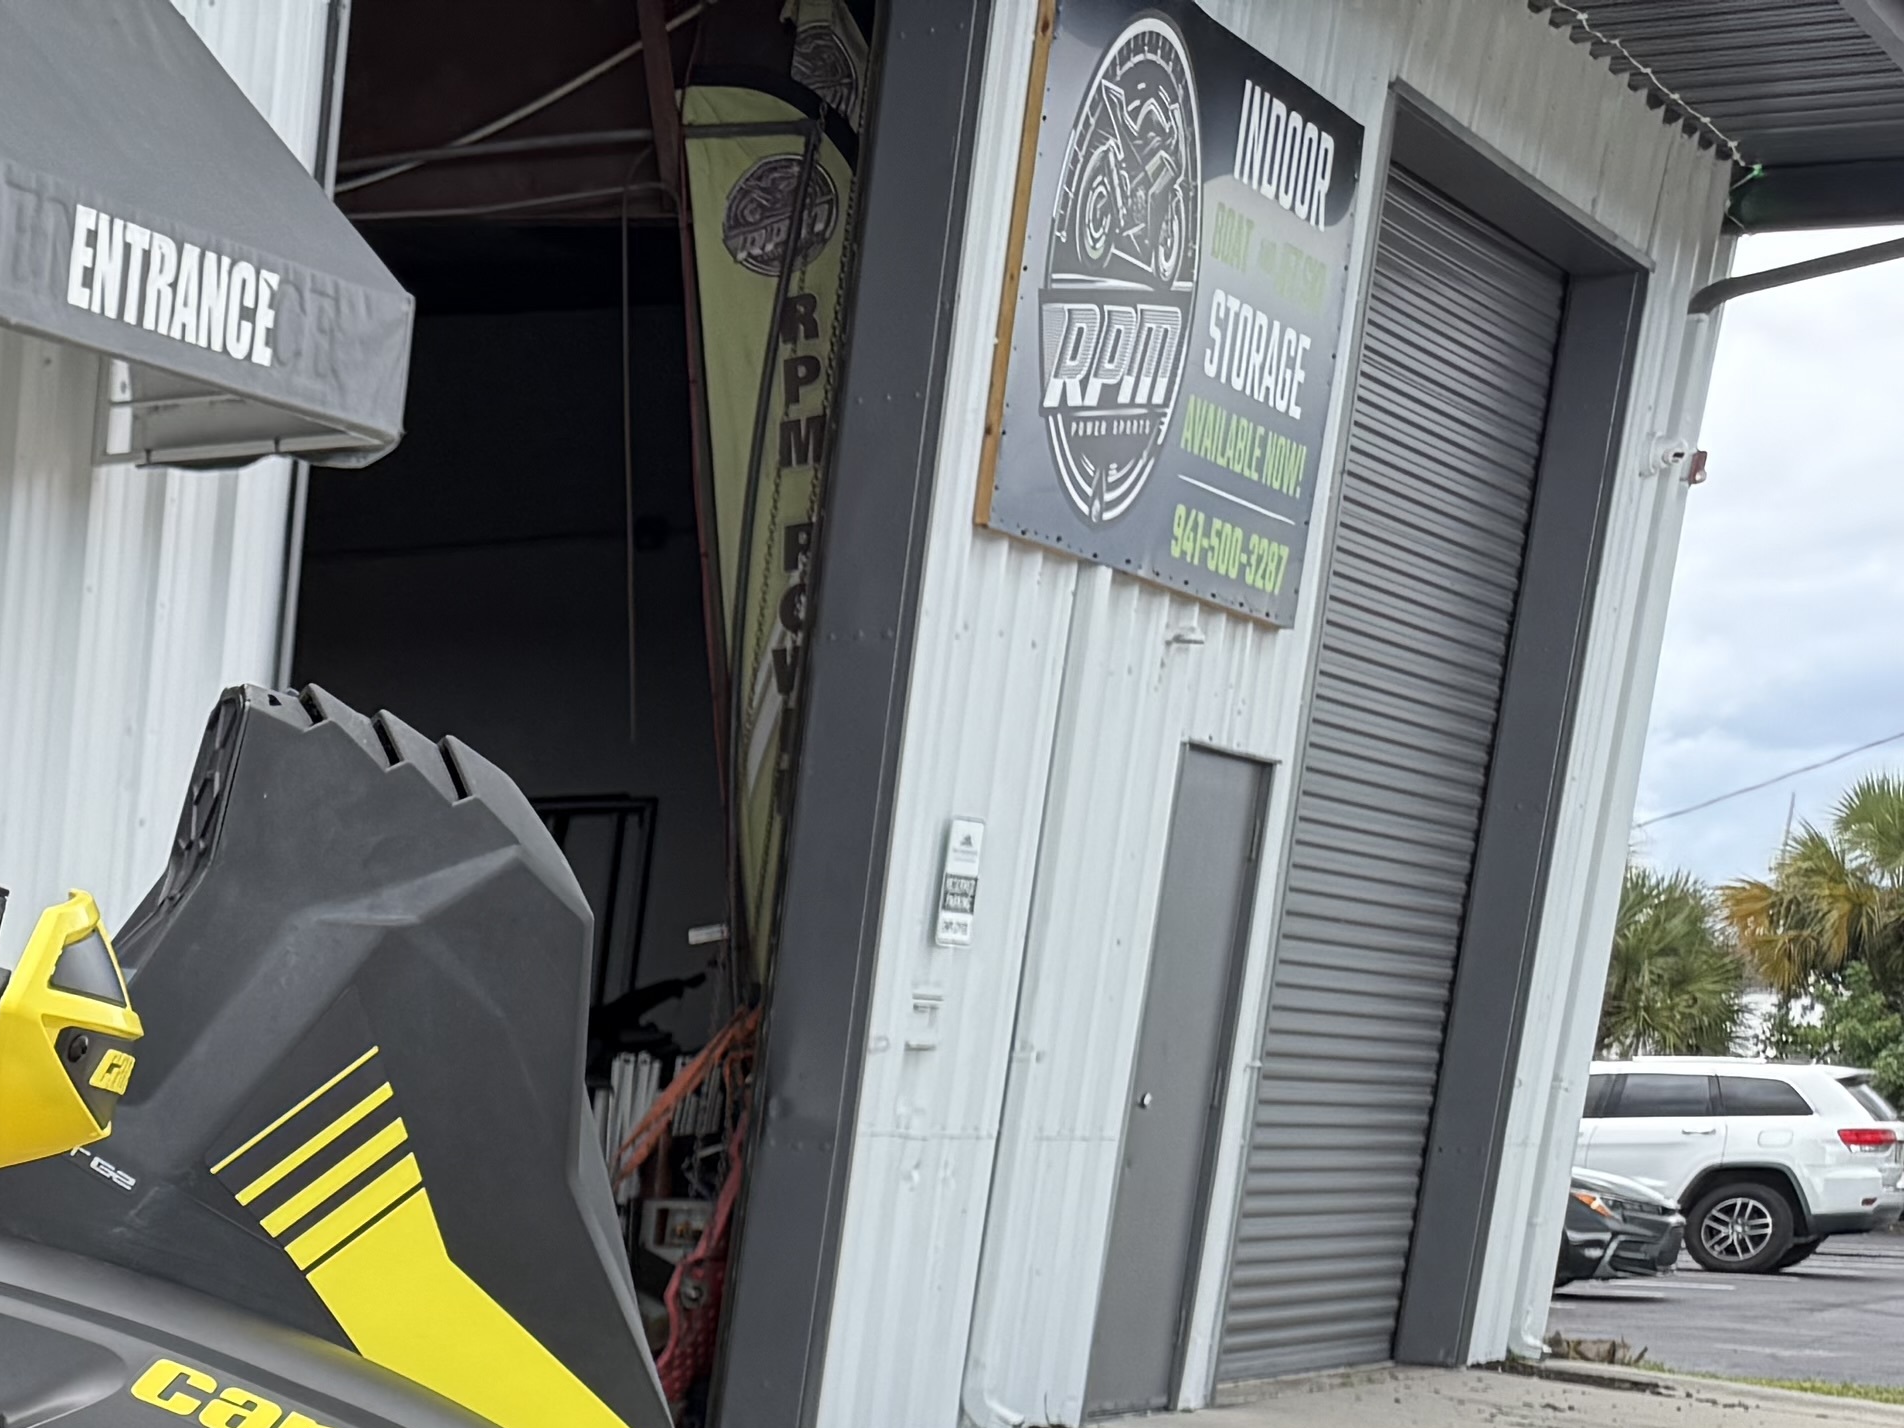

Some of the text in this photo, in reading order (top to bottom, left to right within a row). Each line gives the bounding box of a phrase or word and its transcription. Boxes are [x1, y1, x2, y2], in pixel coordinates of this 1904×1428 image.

[1233, 79, 1335, 233] INDOOR
[68, 204, 280, 367] ENTRANCE
[1043, 303, 1182, 408] RPM
[1204, 288, 1312, 420] STORAGE
[1180, 394, 1307, 499] AVAILABLE NOW!
[1171, 503, 1290, 596] 941-500-3287
[90, 1156, 137, 1191] G2
